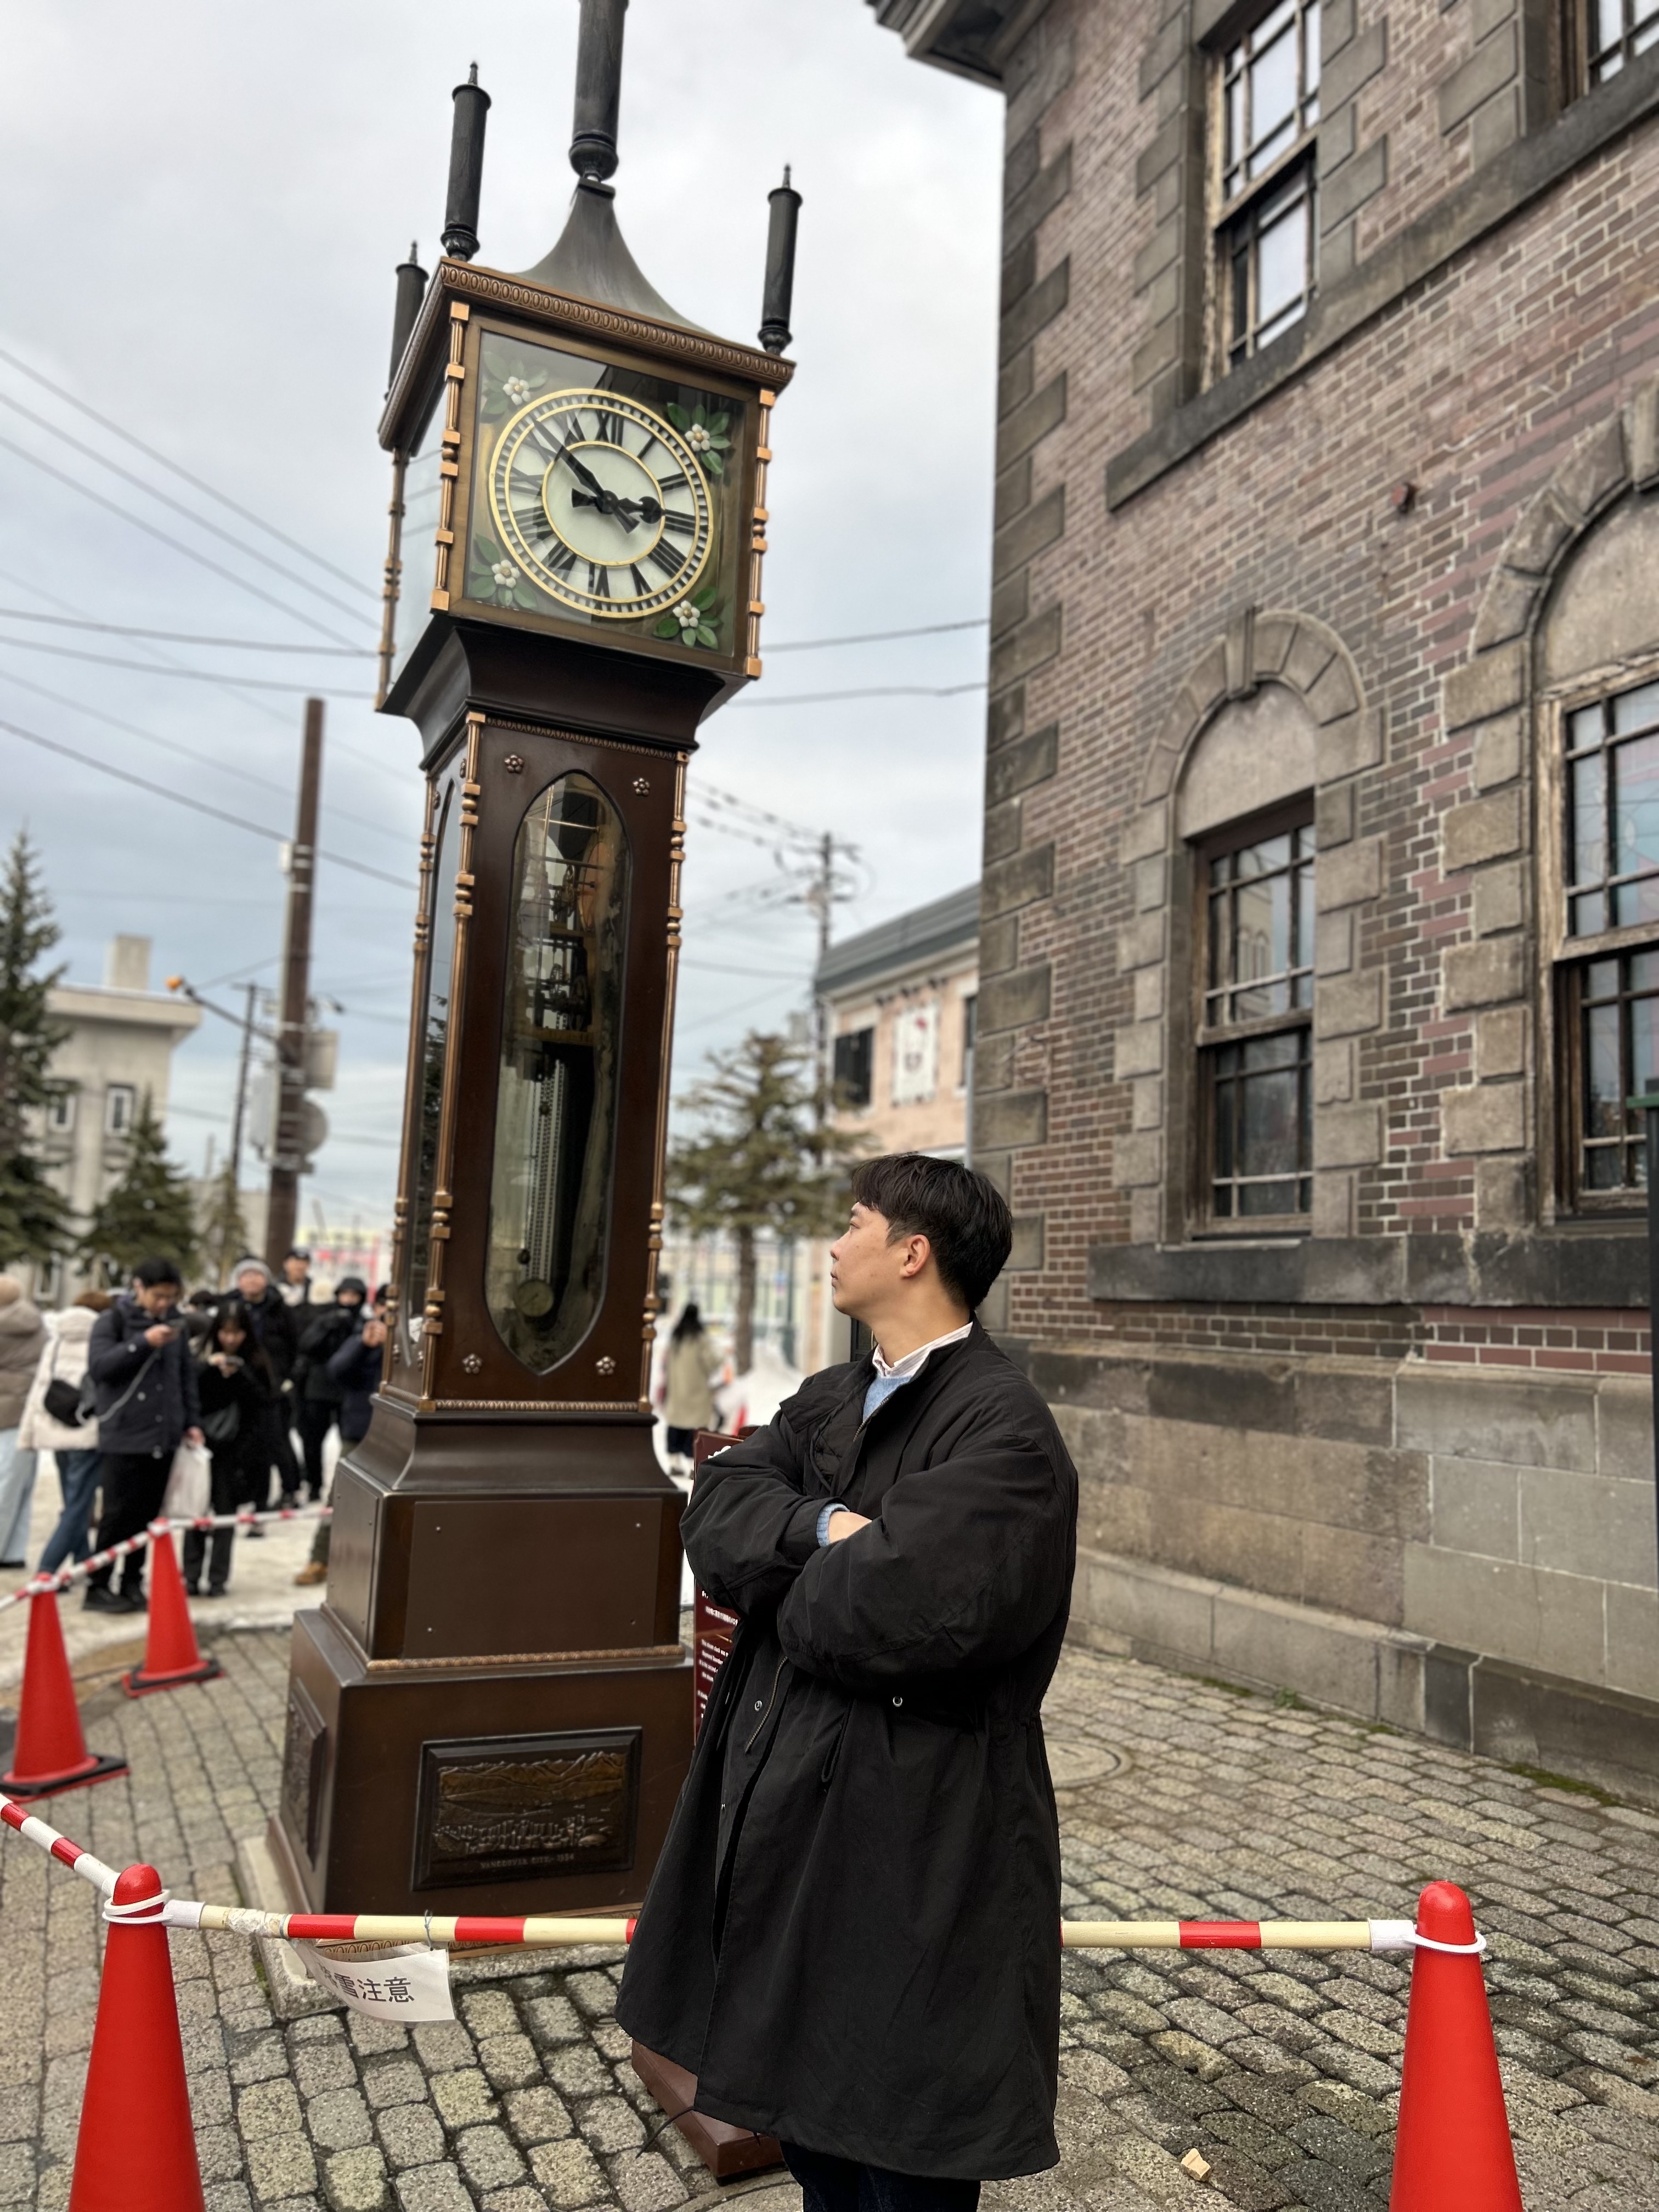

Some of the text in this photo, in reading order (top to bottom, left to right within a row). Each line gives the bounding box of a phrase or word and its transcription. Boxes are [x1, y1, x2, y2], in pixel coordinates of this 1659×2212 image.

[594, 410, 624, 447] XII
[657, 471, 689, 492] II
[664, 509, 695, 535] III
[630, 562, 653, 597] V
